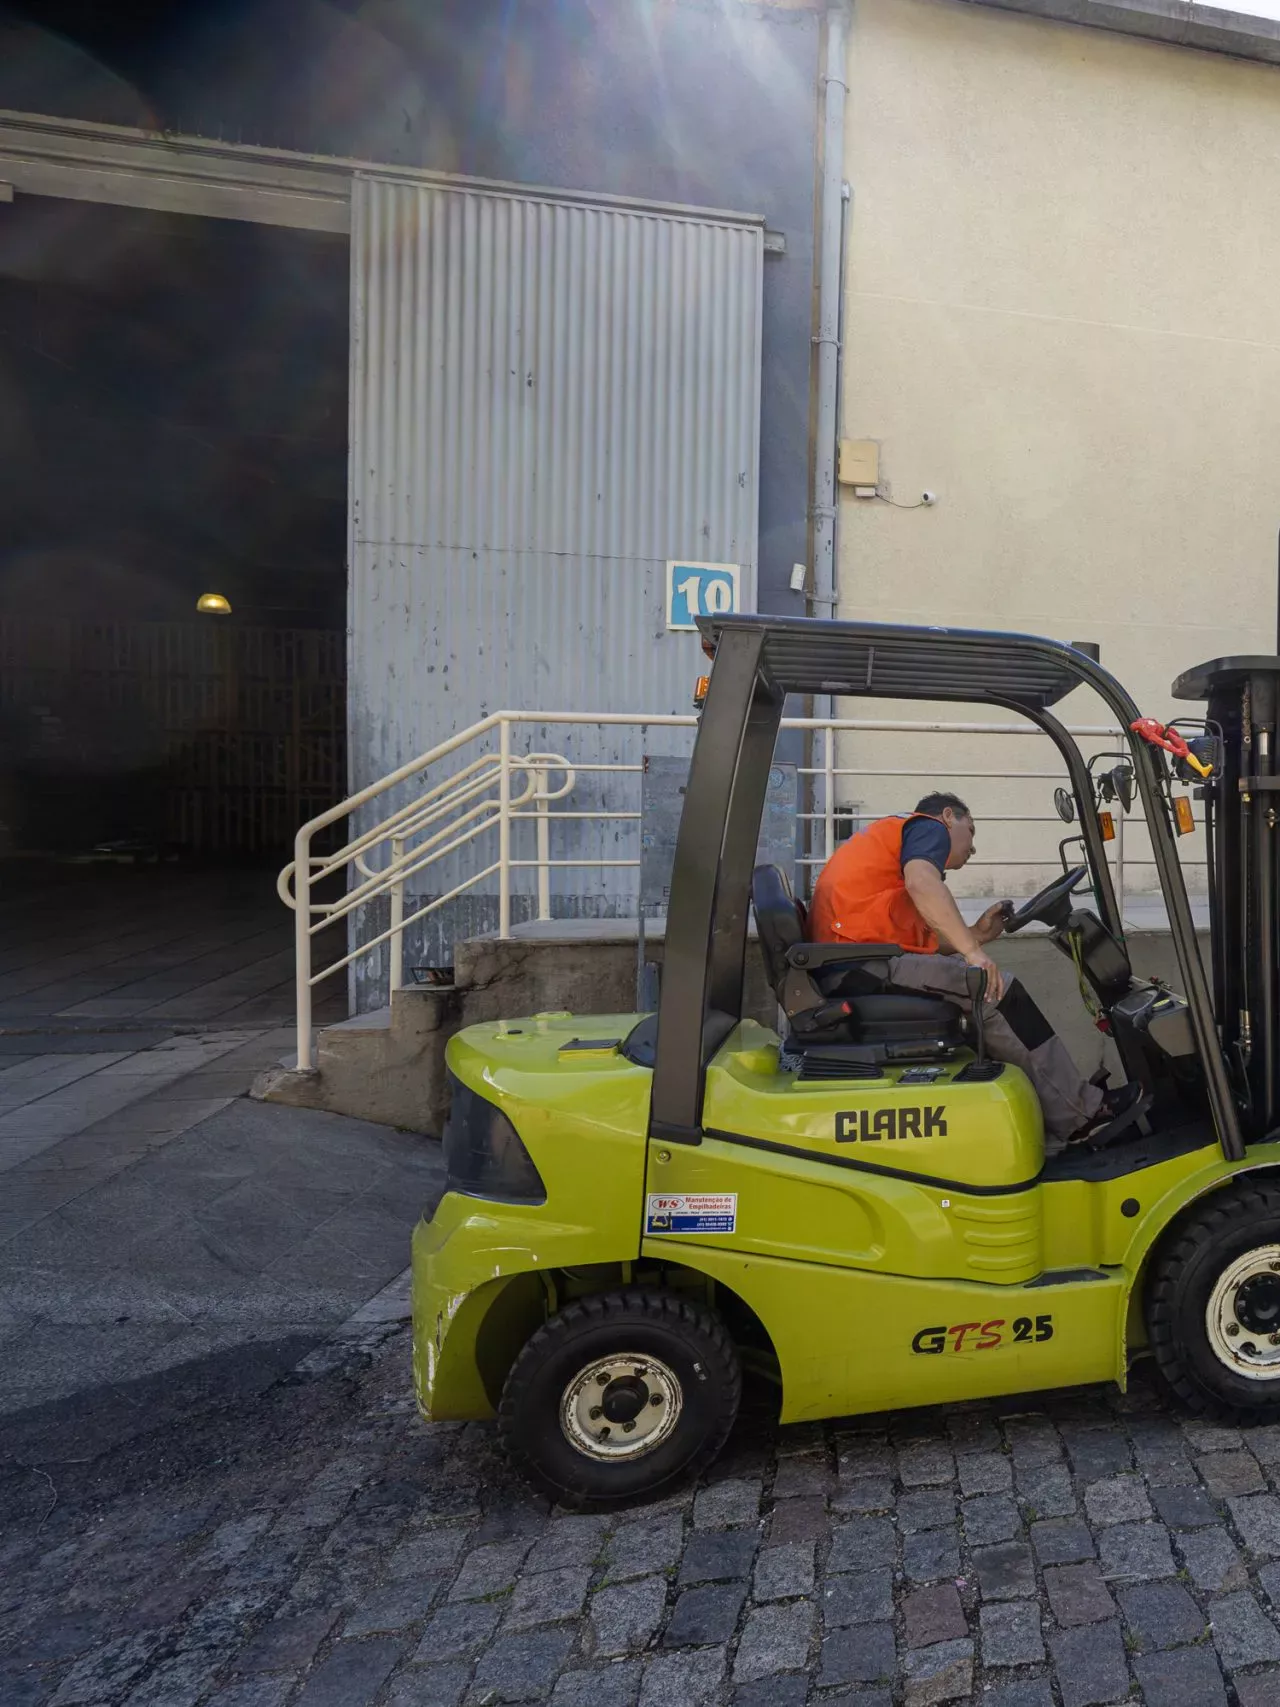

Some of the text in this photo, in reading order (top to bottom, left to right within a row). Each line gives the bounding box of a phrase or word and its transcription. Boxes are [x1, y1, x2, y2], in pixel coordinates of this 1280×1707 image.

[677, 577, 732, 614] 10
[835, 1105, 947, 1143] CLARK
[658, 1200, 679, 1208] WS
[912, 1315, 1054, 1353] GTS 25
